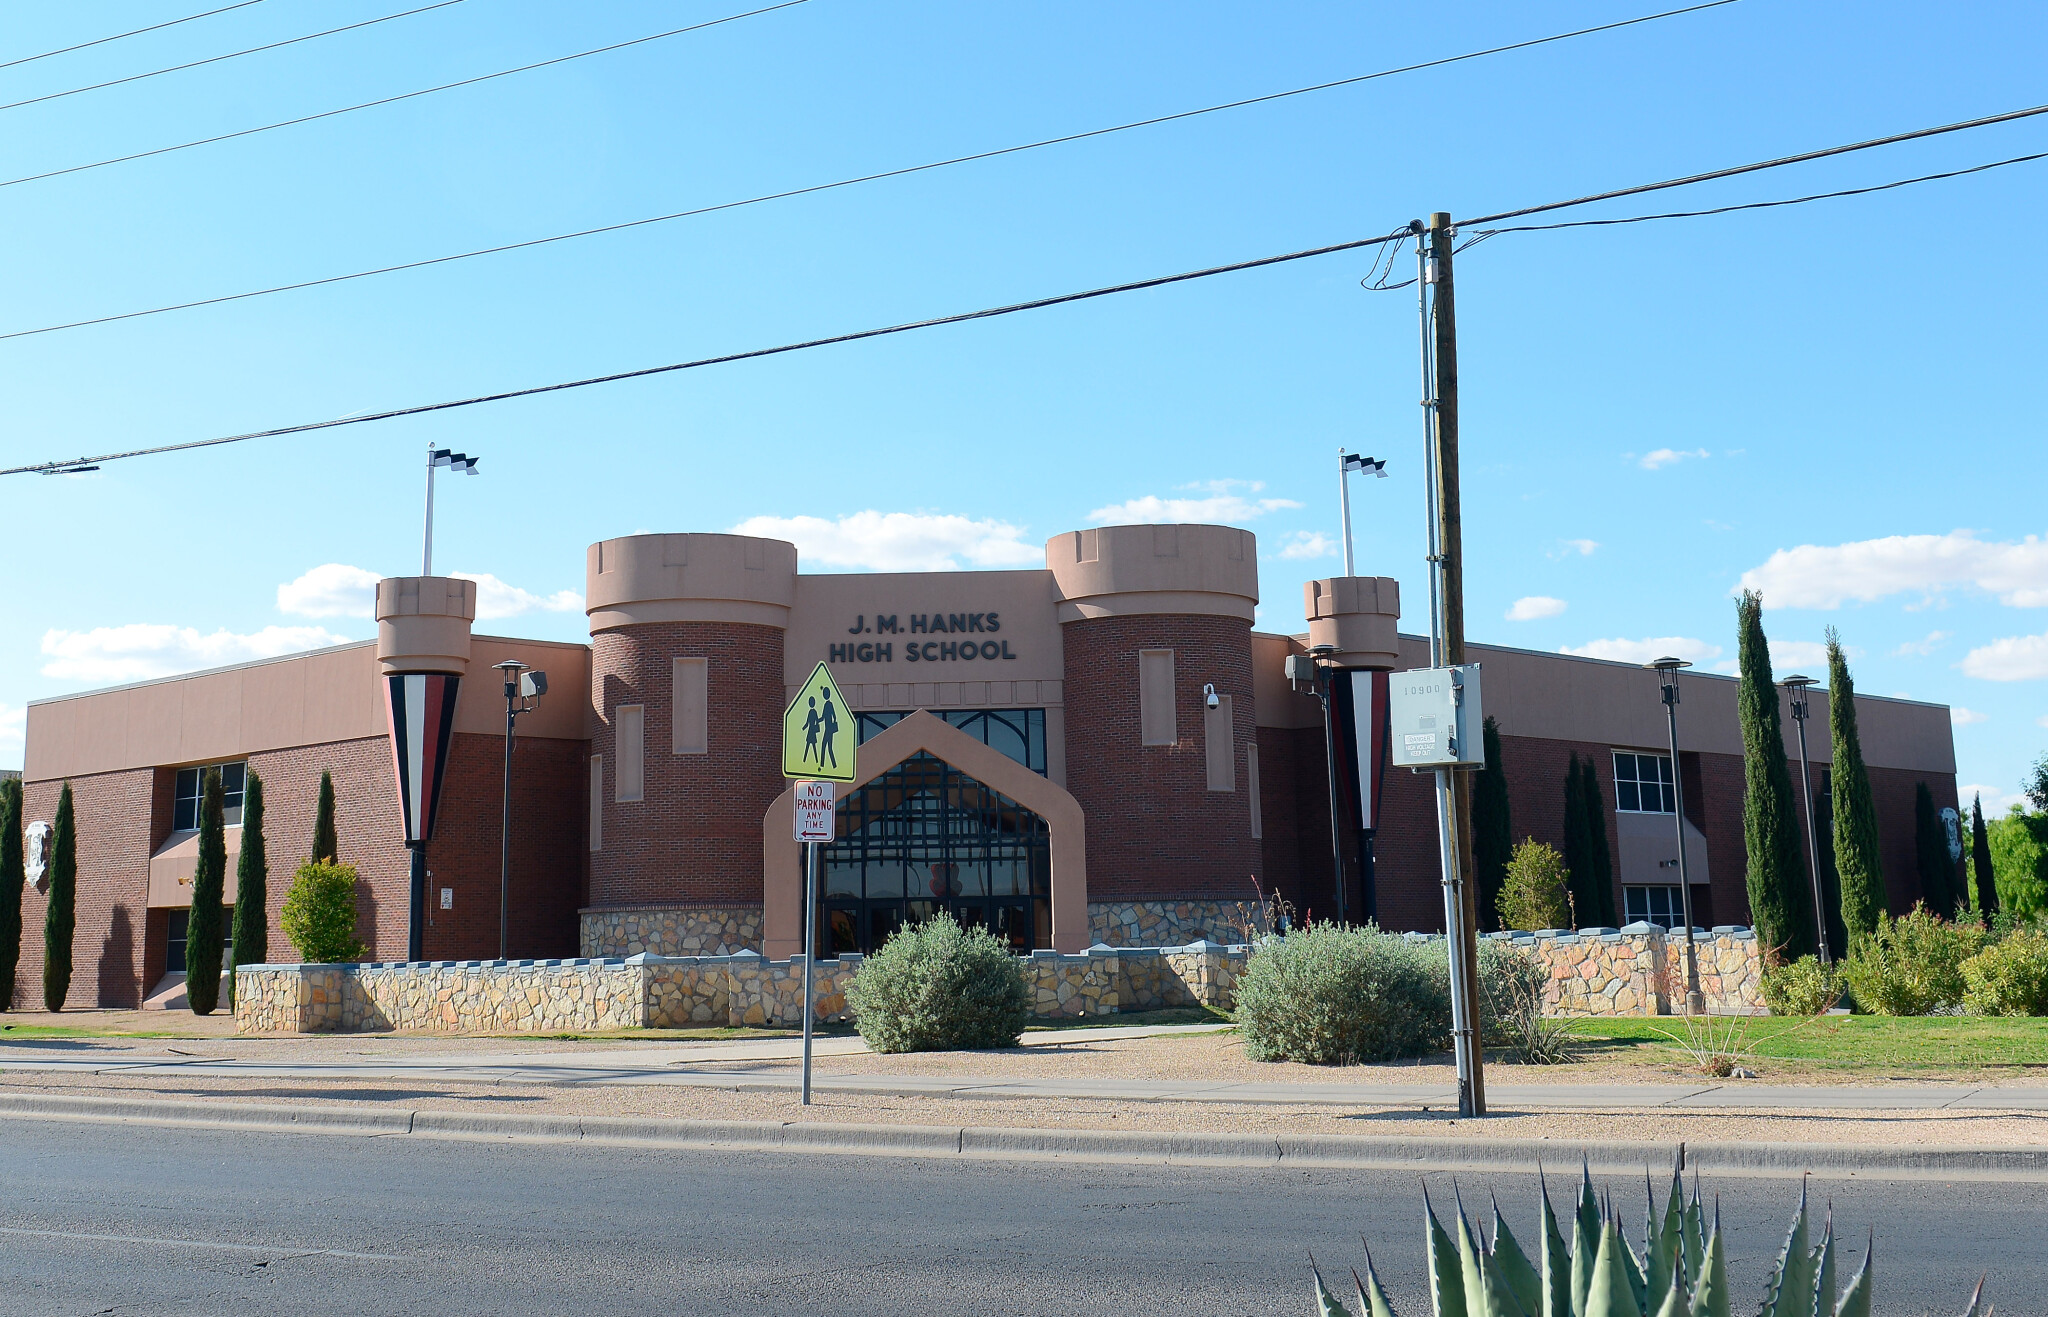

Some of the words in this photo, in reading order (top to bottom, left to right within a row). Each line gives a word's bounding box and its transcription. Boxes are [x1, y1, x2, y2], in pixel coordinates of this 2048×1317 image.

[911, 613, 1000, 633] HANKS
[829, 643, 892, 663] HIGH
[906, 640, 1016, 662] SCHOOL
[1404, 685, 1440, 695] 10900
[808, 786, 822, 796] NO
[798, 799, 831, 810] PARKING
